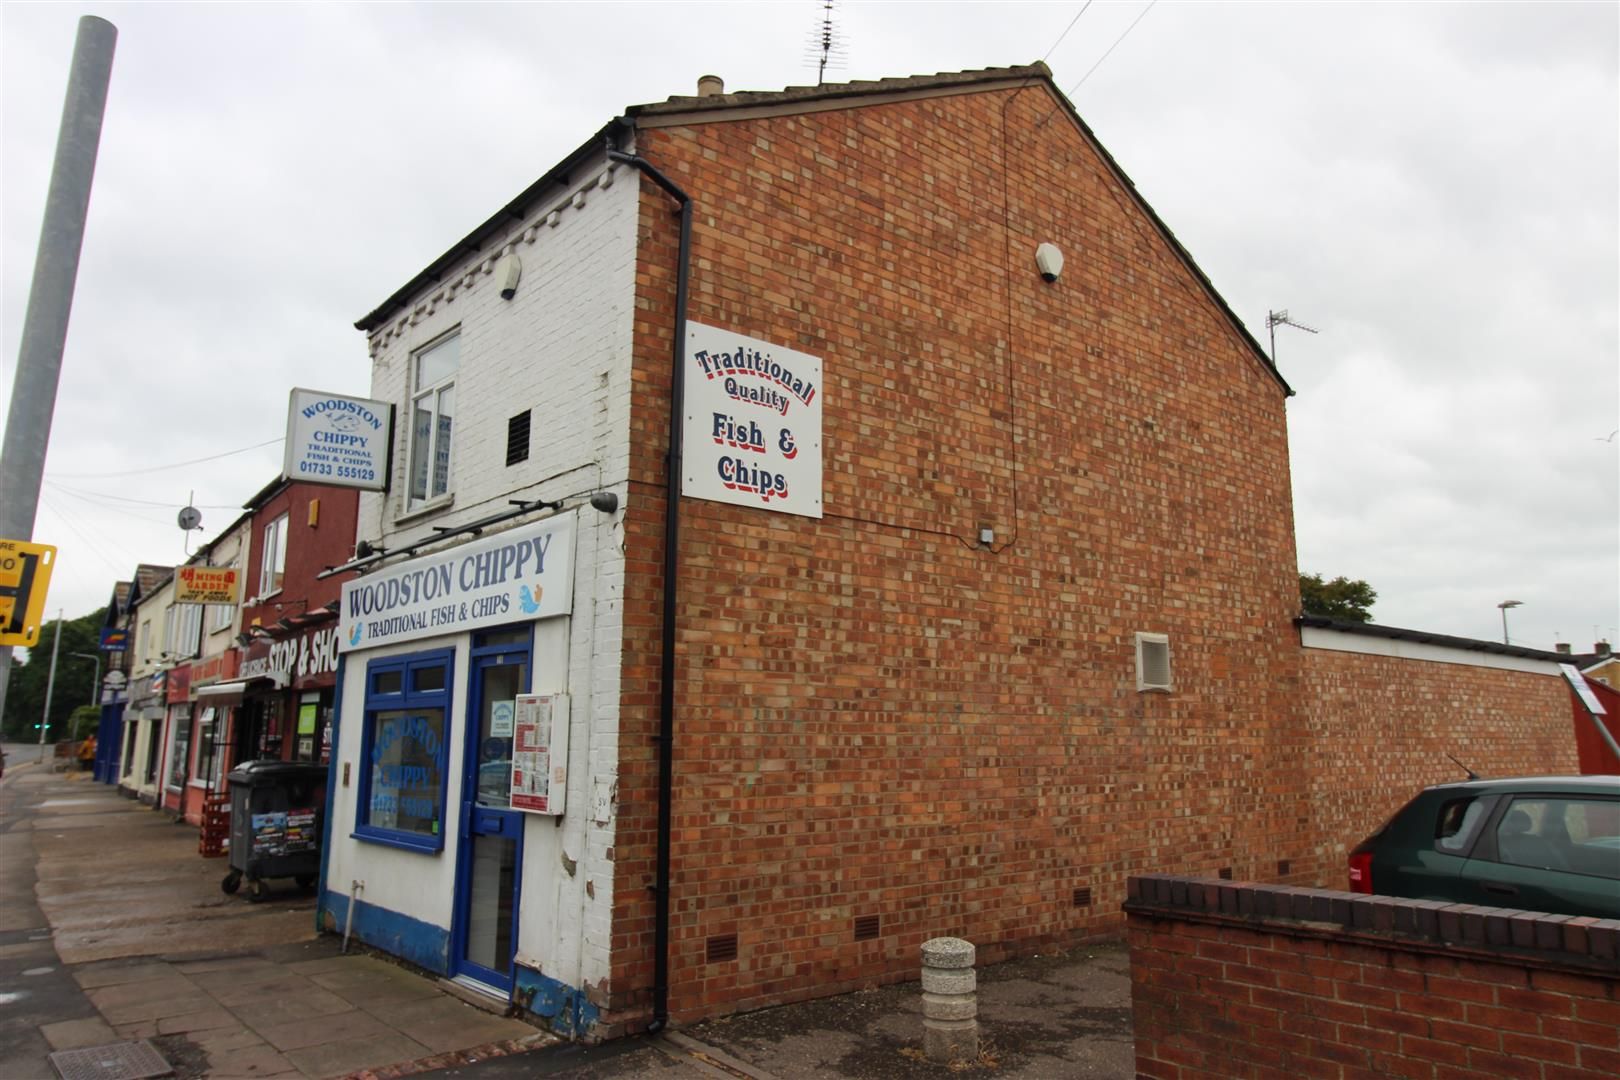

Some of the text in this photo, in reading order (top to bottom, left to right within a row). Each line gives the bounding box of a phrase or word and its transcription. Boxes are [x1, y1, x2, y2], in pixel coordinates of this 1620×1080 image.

[695, 347, 814, 404] Traditional
[725, 377, 788, 414] Quality
[302, 399, 382, 430] WOODSTON
[308, 443, 373, 458] TRADITIONAL
[313, 431, 368, 448] CHIPPY
[713, 412, 797, 458] Fish &
[300, 461, 375, 480] 01733 555129
[306, 452, 329, 462] FISH
[342, 457, 372, 467] CHIPS
[718, 456, 787, 500] Chips
[187, 582, 229, 591] GARDEN
[196, 573, 223, 581] MING
[350, 534, 552, 618] WOODSTON CHIPPY
[368, 593, 510, 639] TRADITIONAL FISH & CHIPS
[268, 639, 298, 674] STOP
[297, 634, 309, 677] &
[310, 626, 340, 675] SHO
